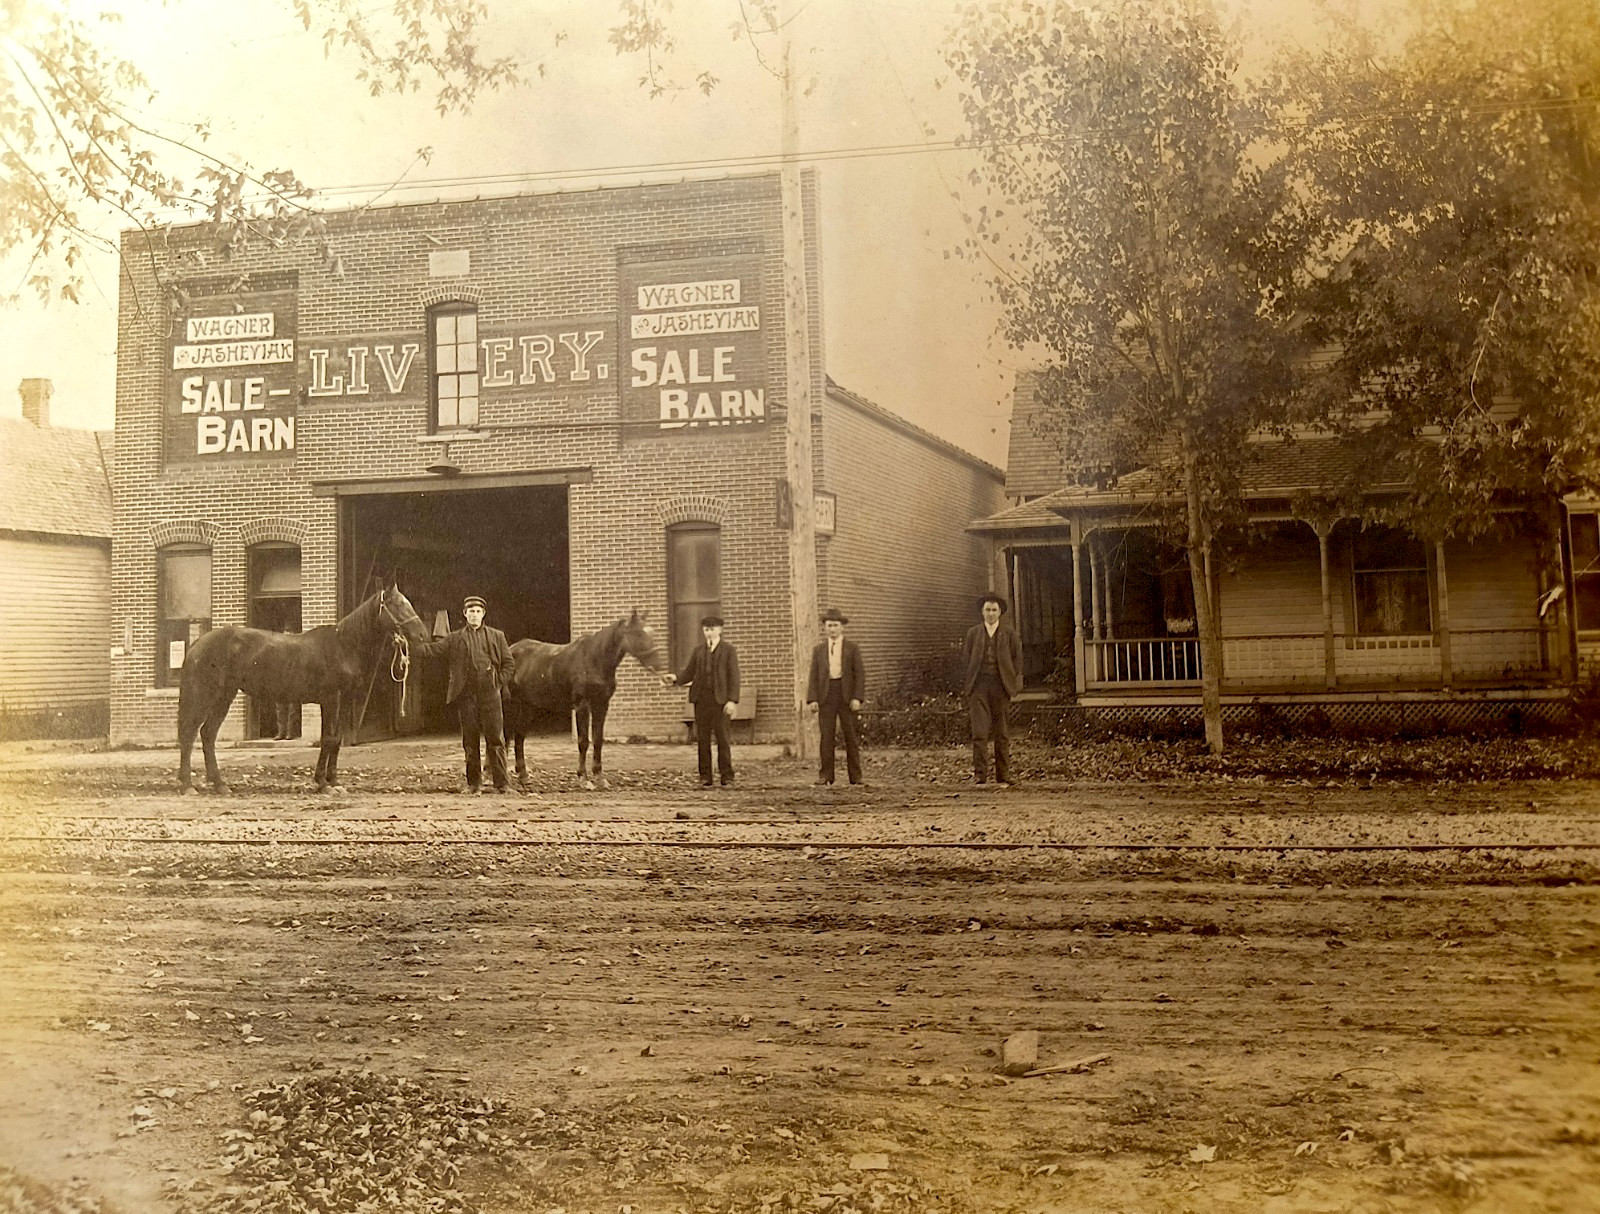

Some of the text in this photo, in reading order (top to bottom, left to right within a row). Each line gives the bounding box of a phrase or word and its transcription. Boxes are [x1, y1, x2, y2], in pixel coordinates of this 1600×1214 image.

[643, 283, 735, 307] WAGNER
[191, 317, 271, 338] WAGNER
[308, 330, 609, 397] LIV ERY.
[631, 346, 736, 388] SALE
[660, 388, 765, 429] BARN
[197, 416, 294, 455] BARN
